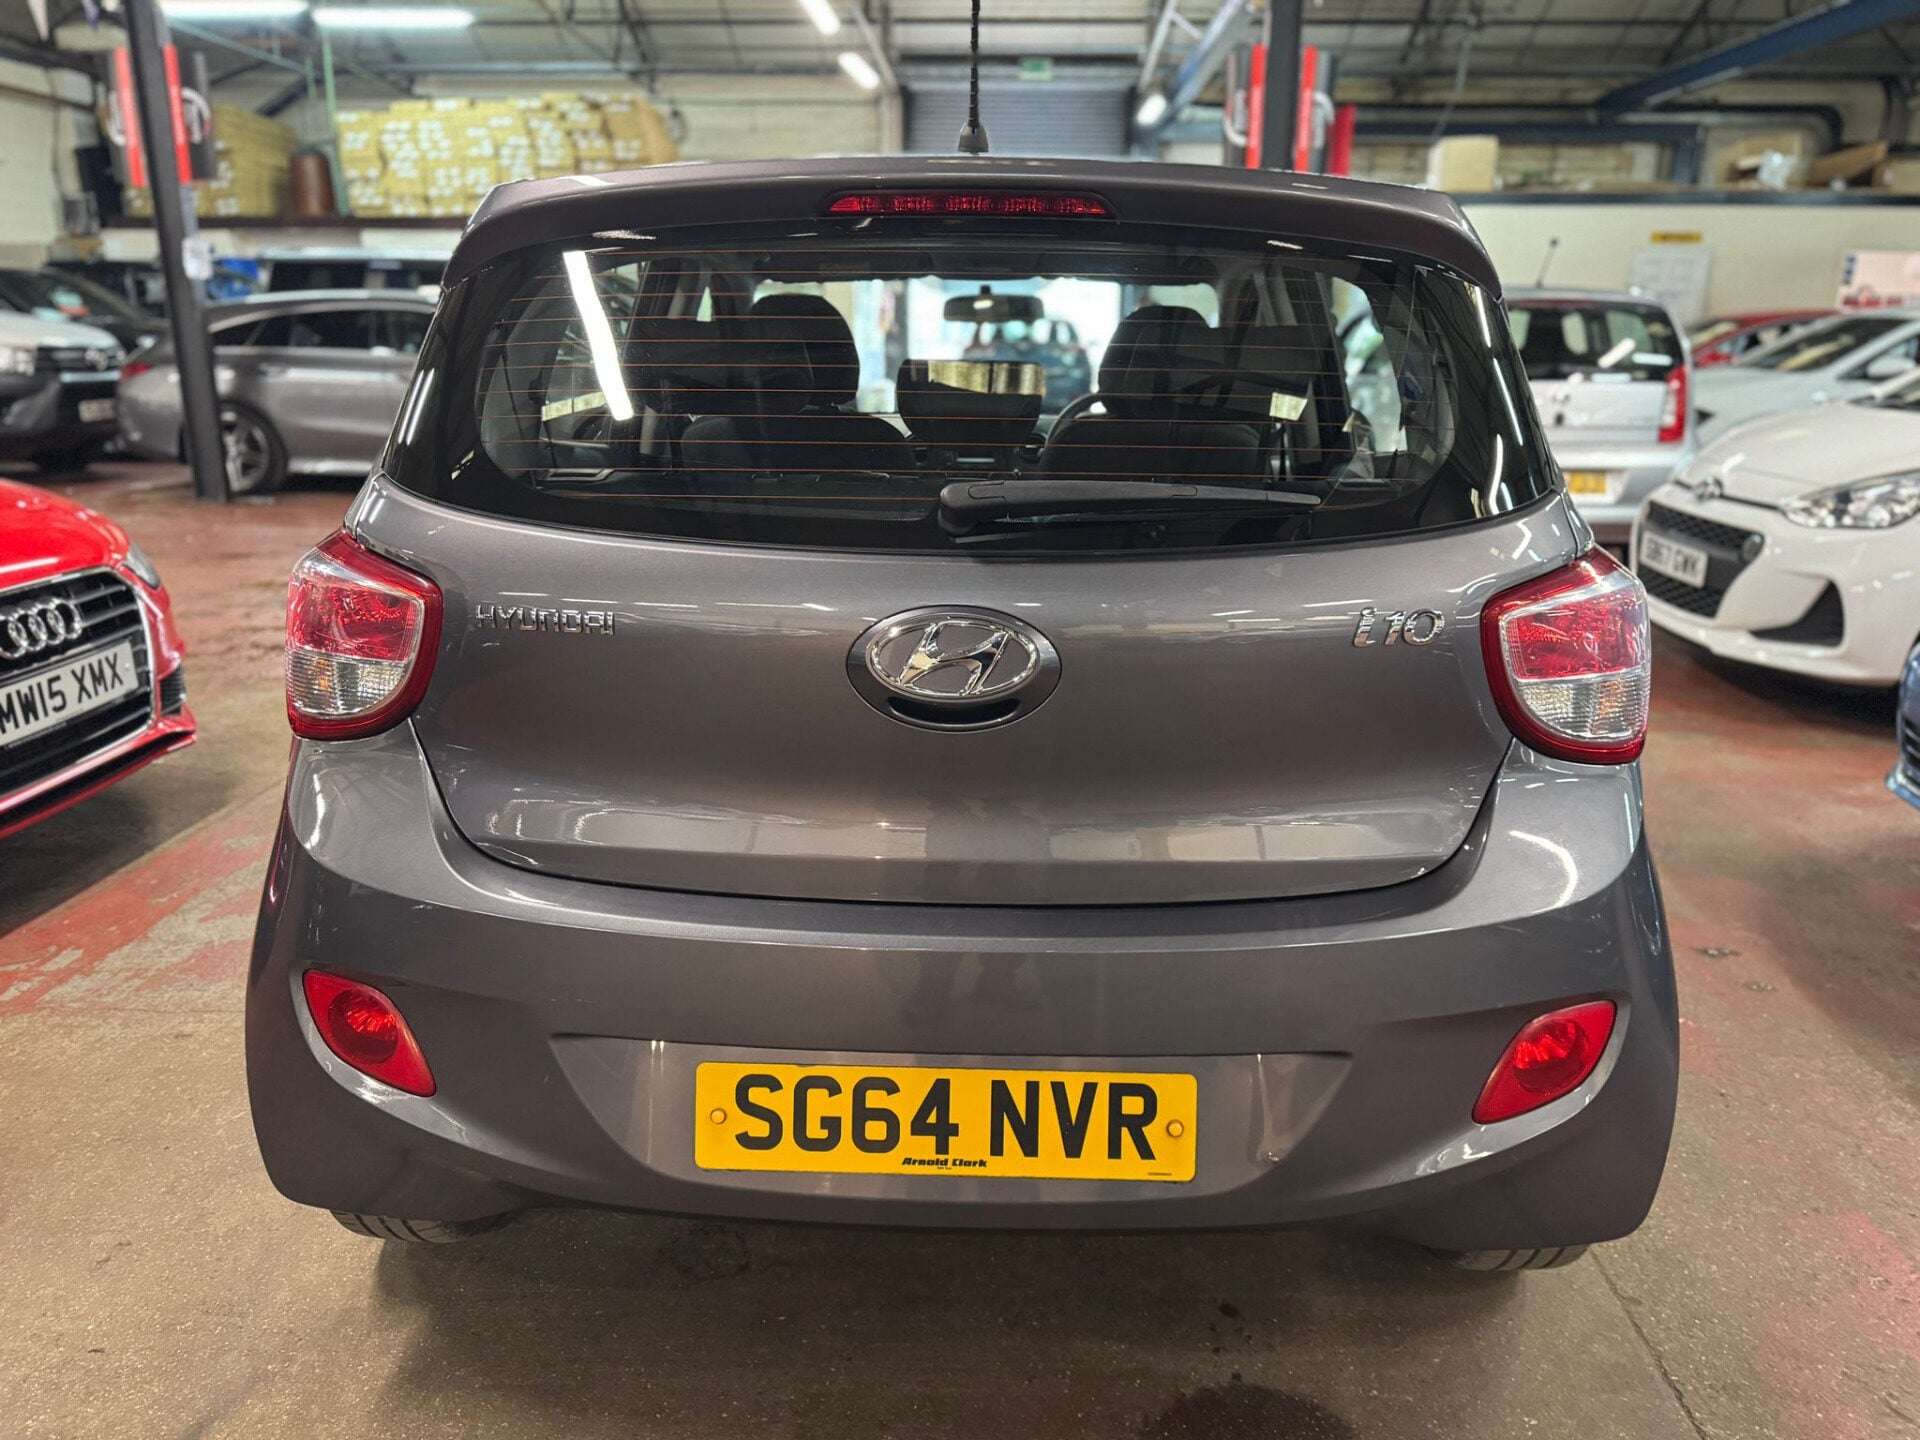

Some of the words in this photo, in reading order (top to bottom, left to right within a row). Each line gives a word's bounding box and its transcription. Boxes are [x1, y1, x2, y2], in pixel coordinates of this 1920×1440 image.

[475, 603, 614, 635] HYUNDAI
[0, 675, 67, 734] MW15
[71, 652, 124, 704] XMX
[735, 1073, 960, 1156] SG64
[989, 1079, 1158, 1161] NVR
[902, 1157, 949, 1167] Arnold
[952, 1158, 987, 1168] Clark
